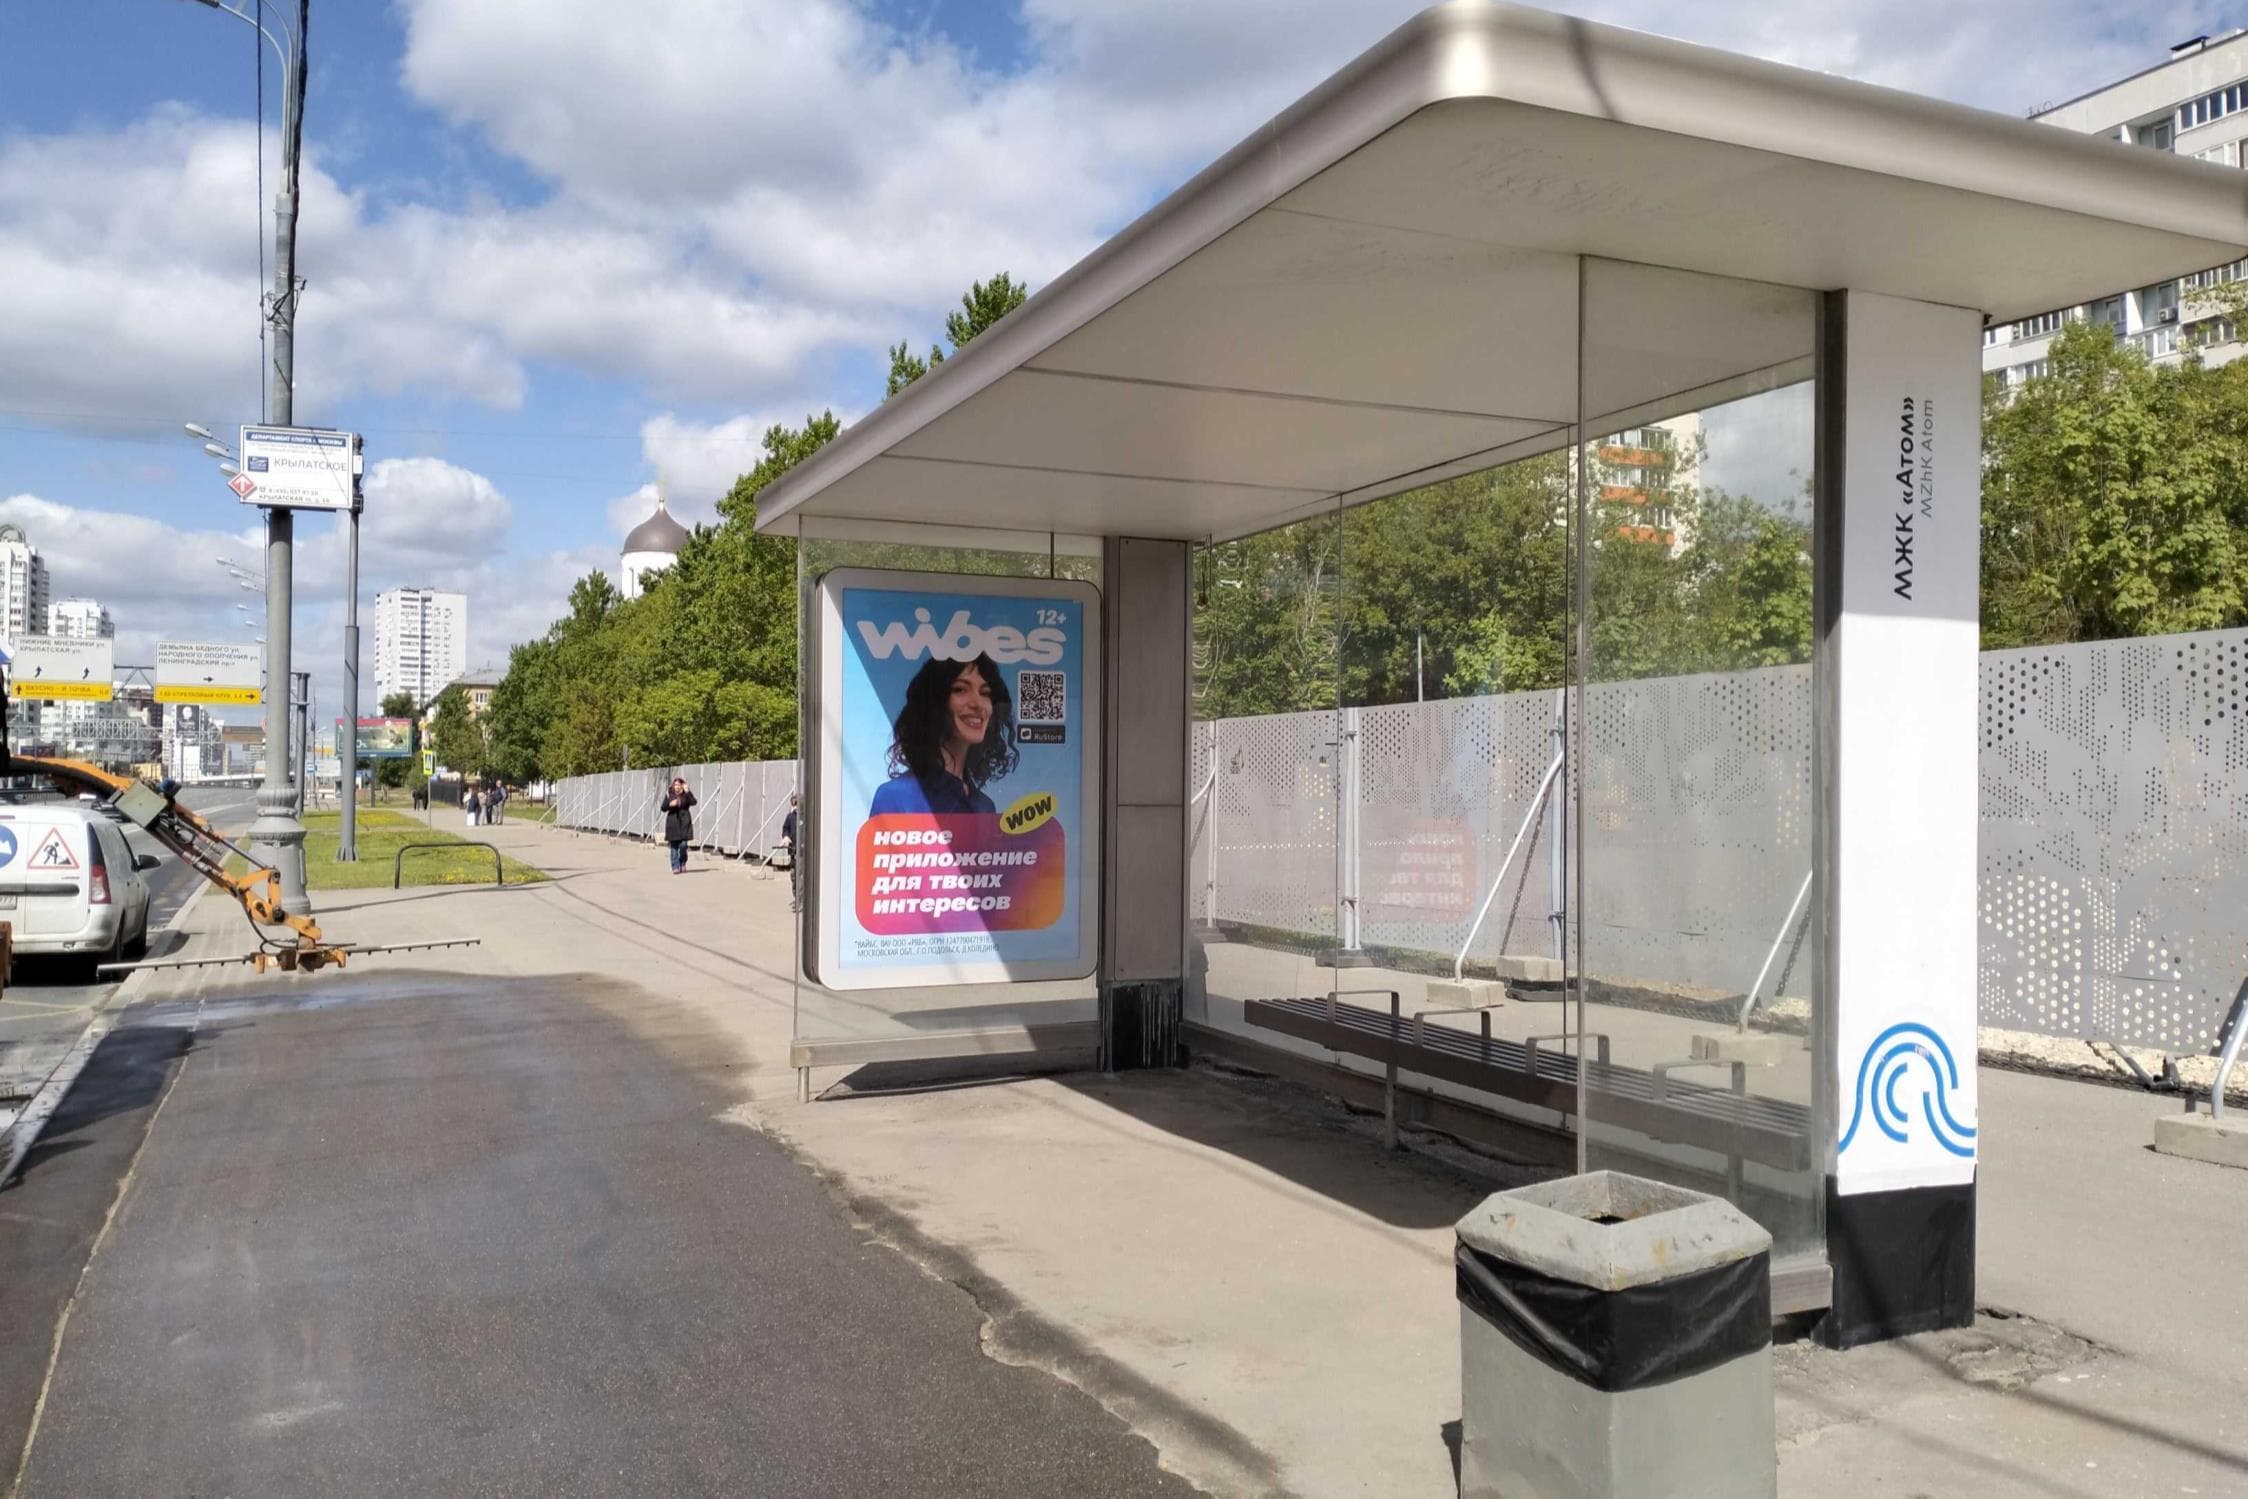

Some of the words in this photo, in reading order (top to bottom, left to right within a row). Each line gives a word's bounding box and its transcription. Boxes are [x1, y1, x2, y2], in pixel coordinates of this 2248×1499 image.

[1921, 400, 1934, 452] Atom
[274, 458, 348, 472] КРЫЛАТСКОЕ
[1920, 457, 1933, 519] MZhK
[1894, 512, 1914, 600] МЖК
[1037, 609, 1067, 625] 12+
[857, 607, 1067, 665] wibes
[1033, 733, 1063, 741] RuStore
[873, 830, 953, 846] новое
[873, 850, 1038, 874] приложение
[871, 875, 922, 895] для
[929, 873, 1003, 890] твоих
[872, 895, 1011, 918] интересов
